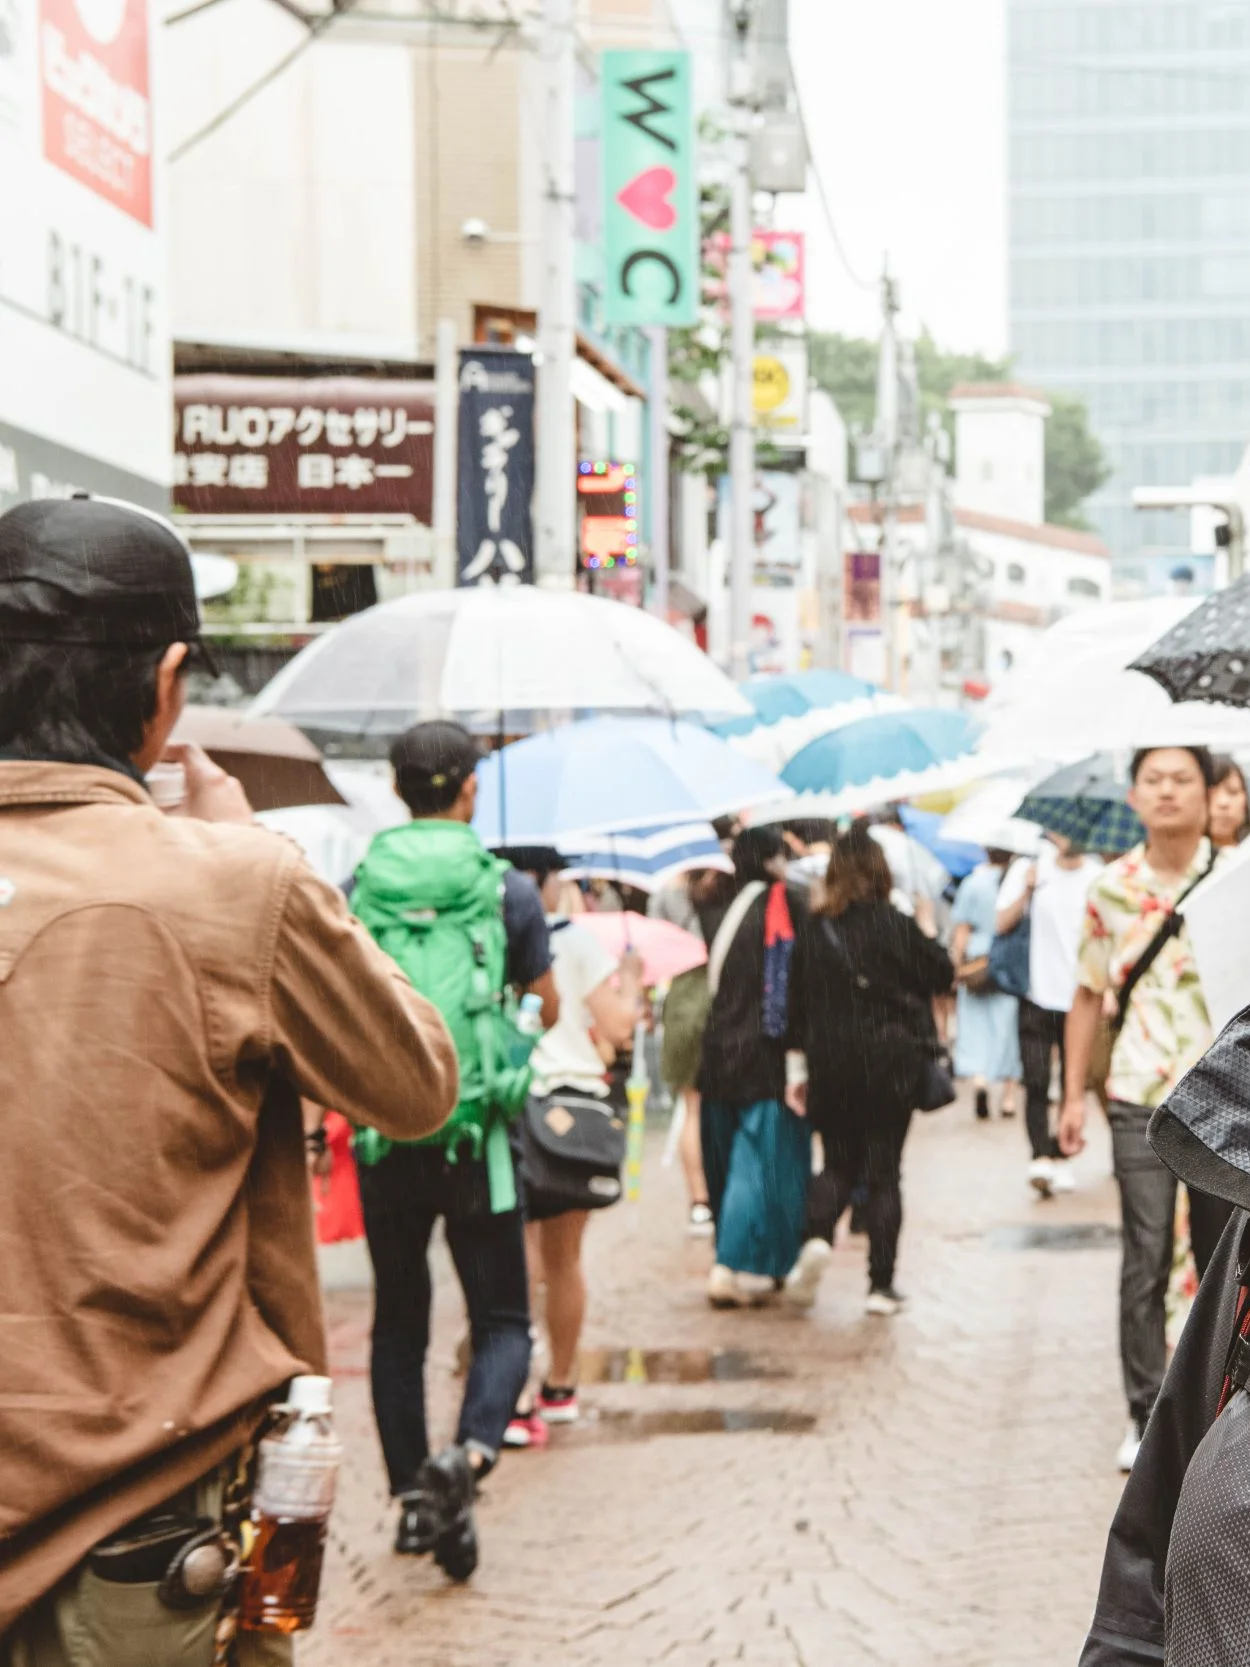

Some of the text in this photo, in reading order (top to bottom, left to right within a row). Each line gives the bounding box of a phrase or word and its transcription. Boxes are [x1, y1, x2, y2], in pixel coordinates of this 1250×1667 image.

[617, 68, 682, 307] W C
[297, 453, 413, 490] 日本一
